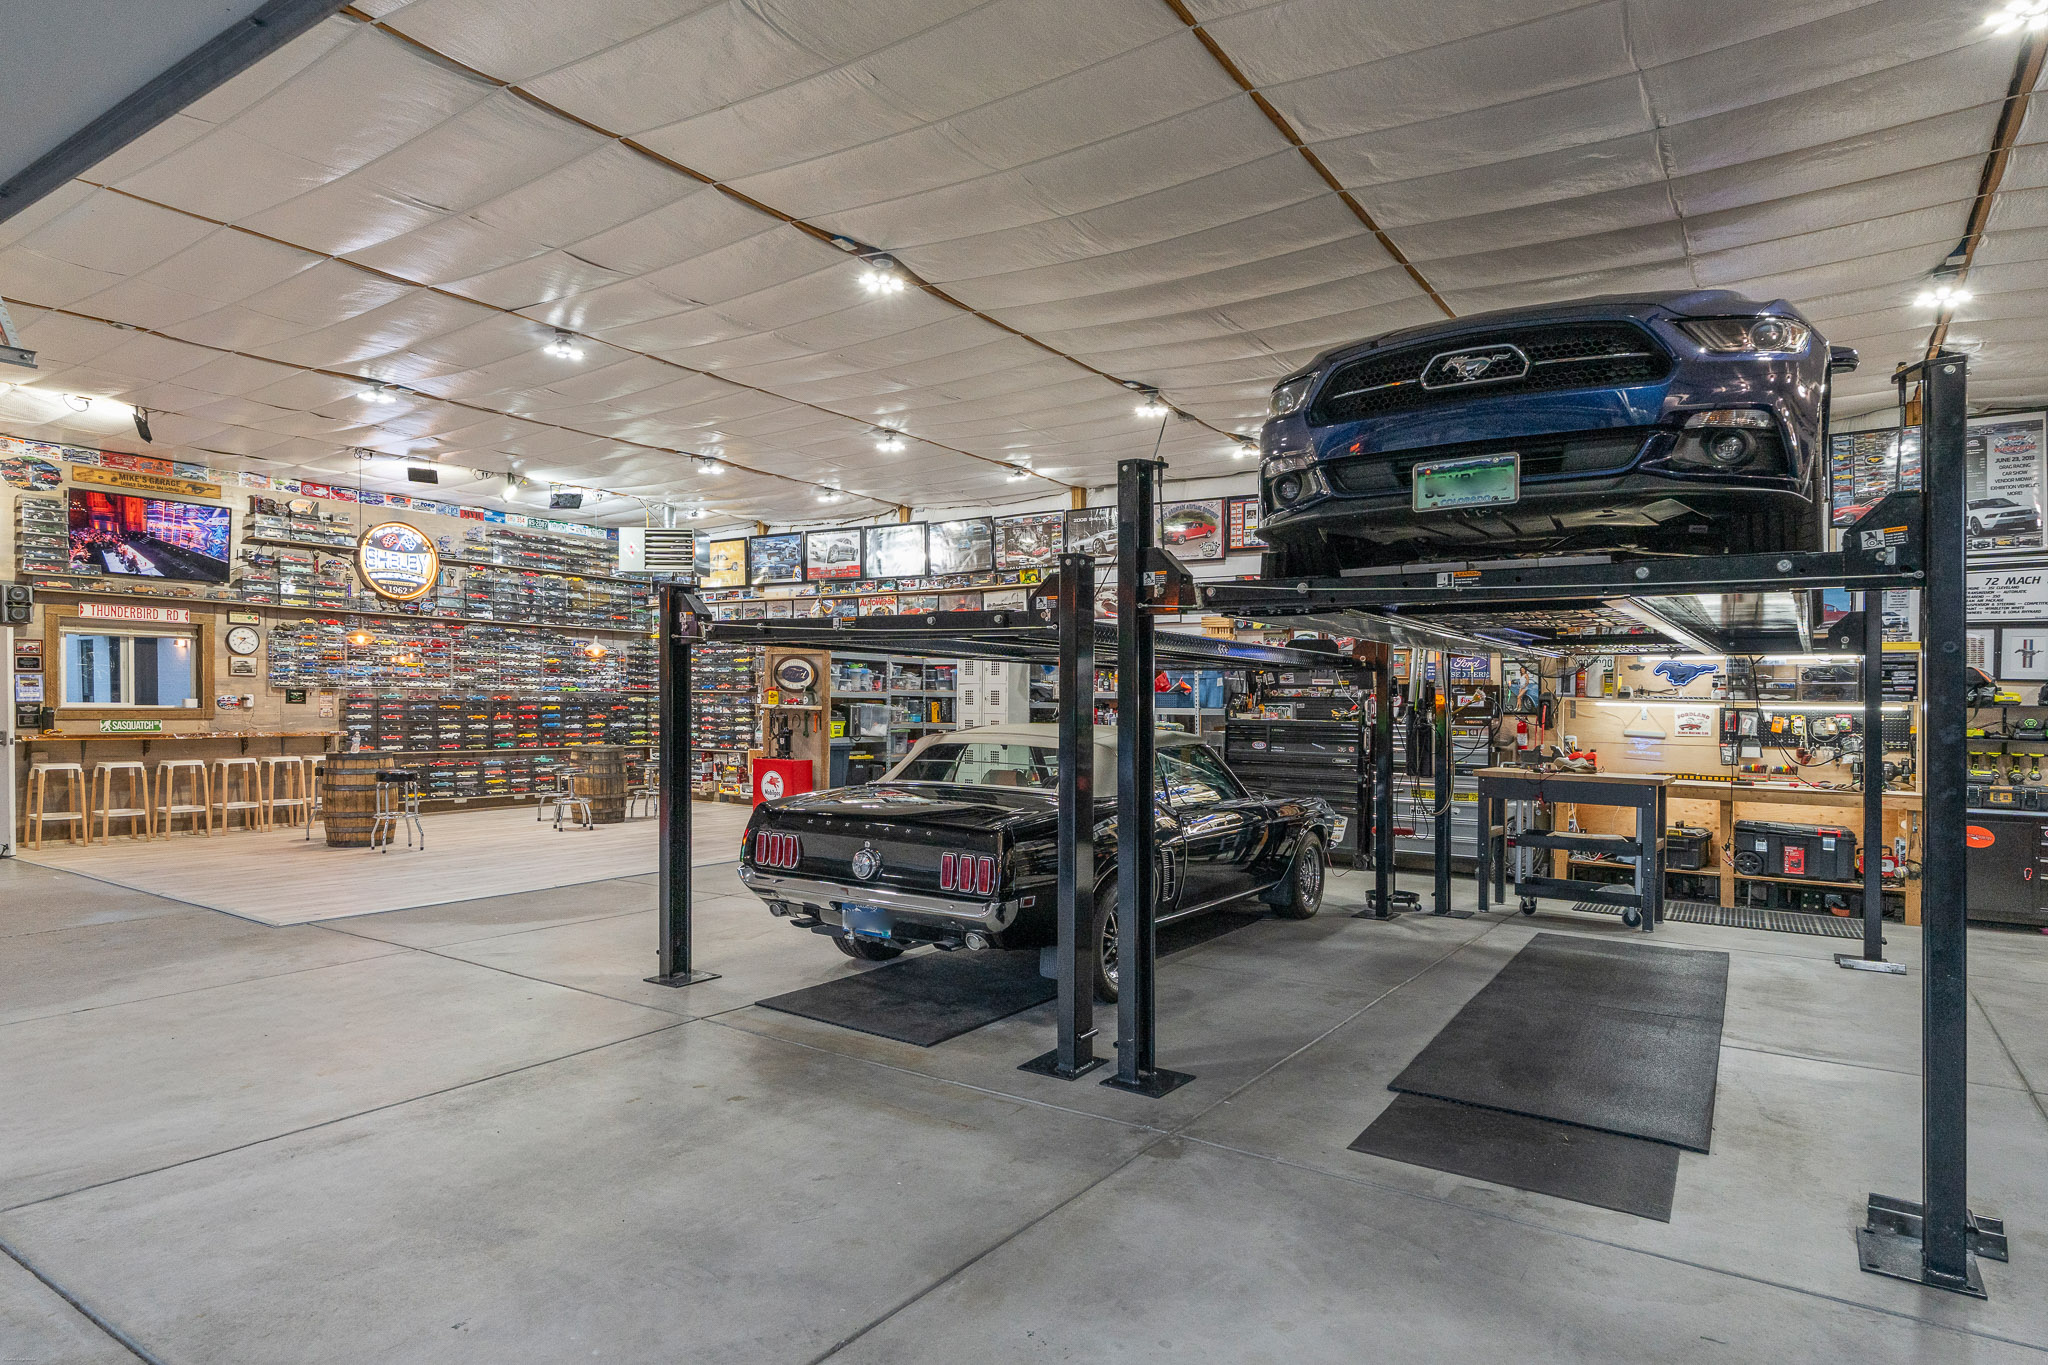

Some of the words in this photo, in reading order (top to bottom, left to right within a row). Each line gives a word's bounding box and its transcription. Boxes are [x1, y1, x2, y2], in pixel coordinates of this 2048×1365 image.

[119, 473, 147, 483] MIKE'S
[149, 477, 181, 487] GARAGE
[1440, 494, 1491, 506] COLORADO
[365, 546, 428, 575] SHELBY
[1985, 577, 2000, 585] 72
[2005, 576, 2041, 585] MACH
[388, 585, 408, 595] 1962
[90, 604, 159, 620] THUNDERBIRD
[166, 609, 179, 621] RD
[1453, 656, 1480, 668] Ford
[1676, 711, 1711, 720] FORDLAND
[112, 720, 154, 730] SASQUATCH
[764, 788, 781, 797] Mobilgas
